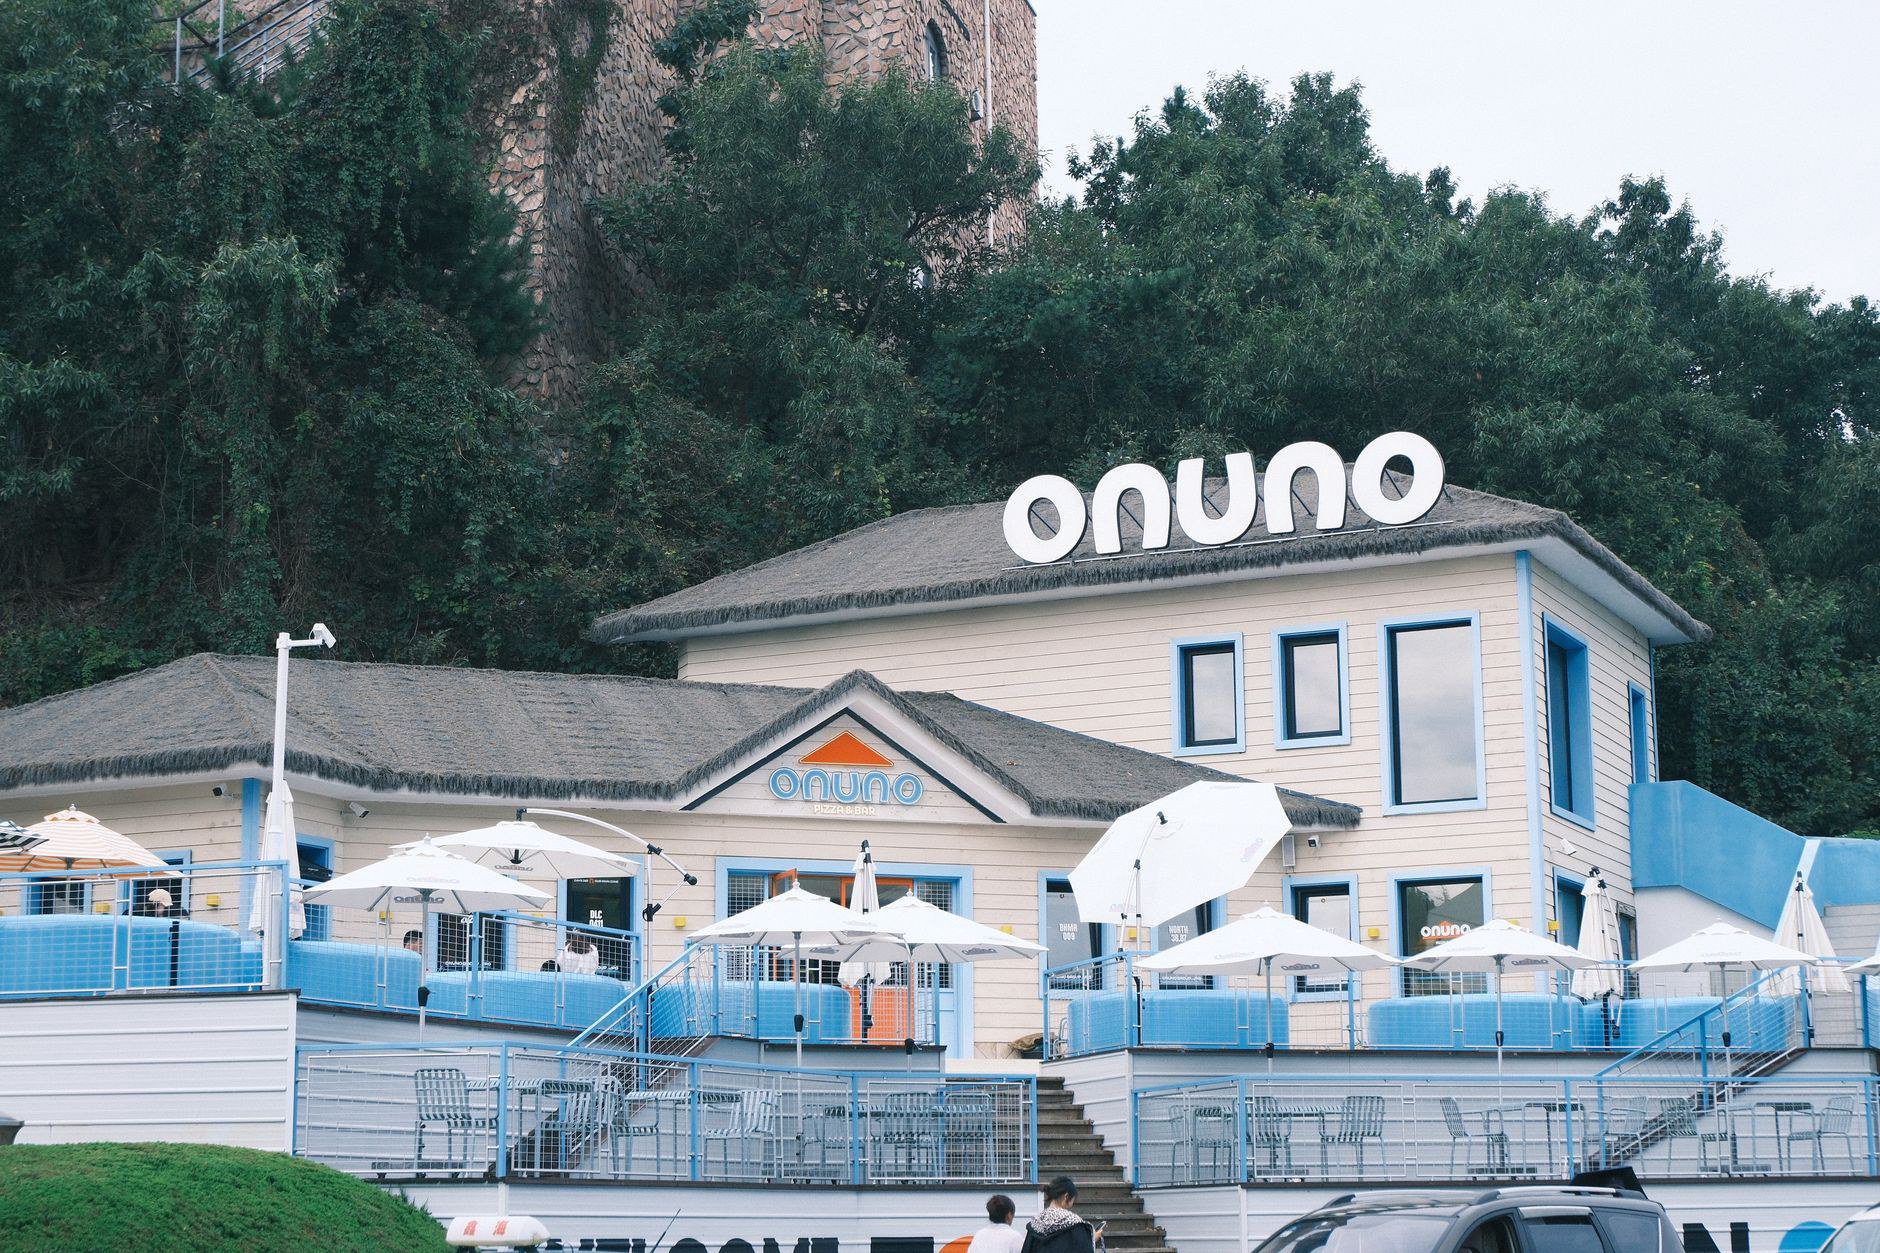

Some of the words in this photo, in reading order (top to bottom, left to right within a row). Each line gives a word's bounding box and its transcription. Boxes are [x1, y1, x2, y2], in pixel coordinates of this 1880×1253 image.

[813, 804, 845, 815] PIZZA
[845, 805, 853, 815] &
[854, 806, 876, 816] BAR
[589, 910, 603, 919] DLC
[1168, 925, 1189, 934] NORTH
